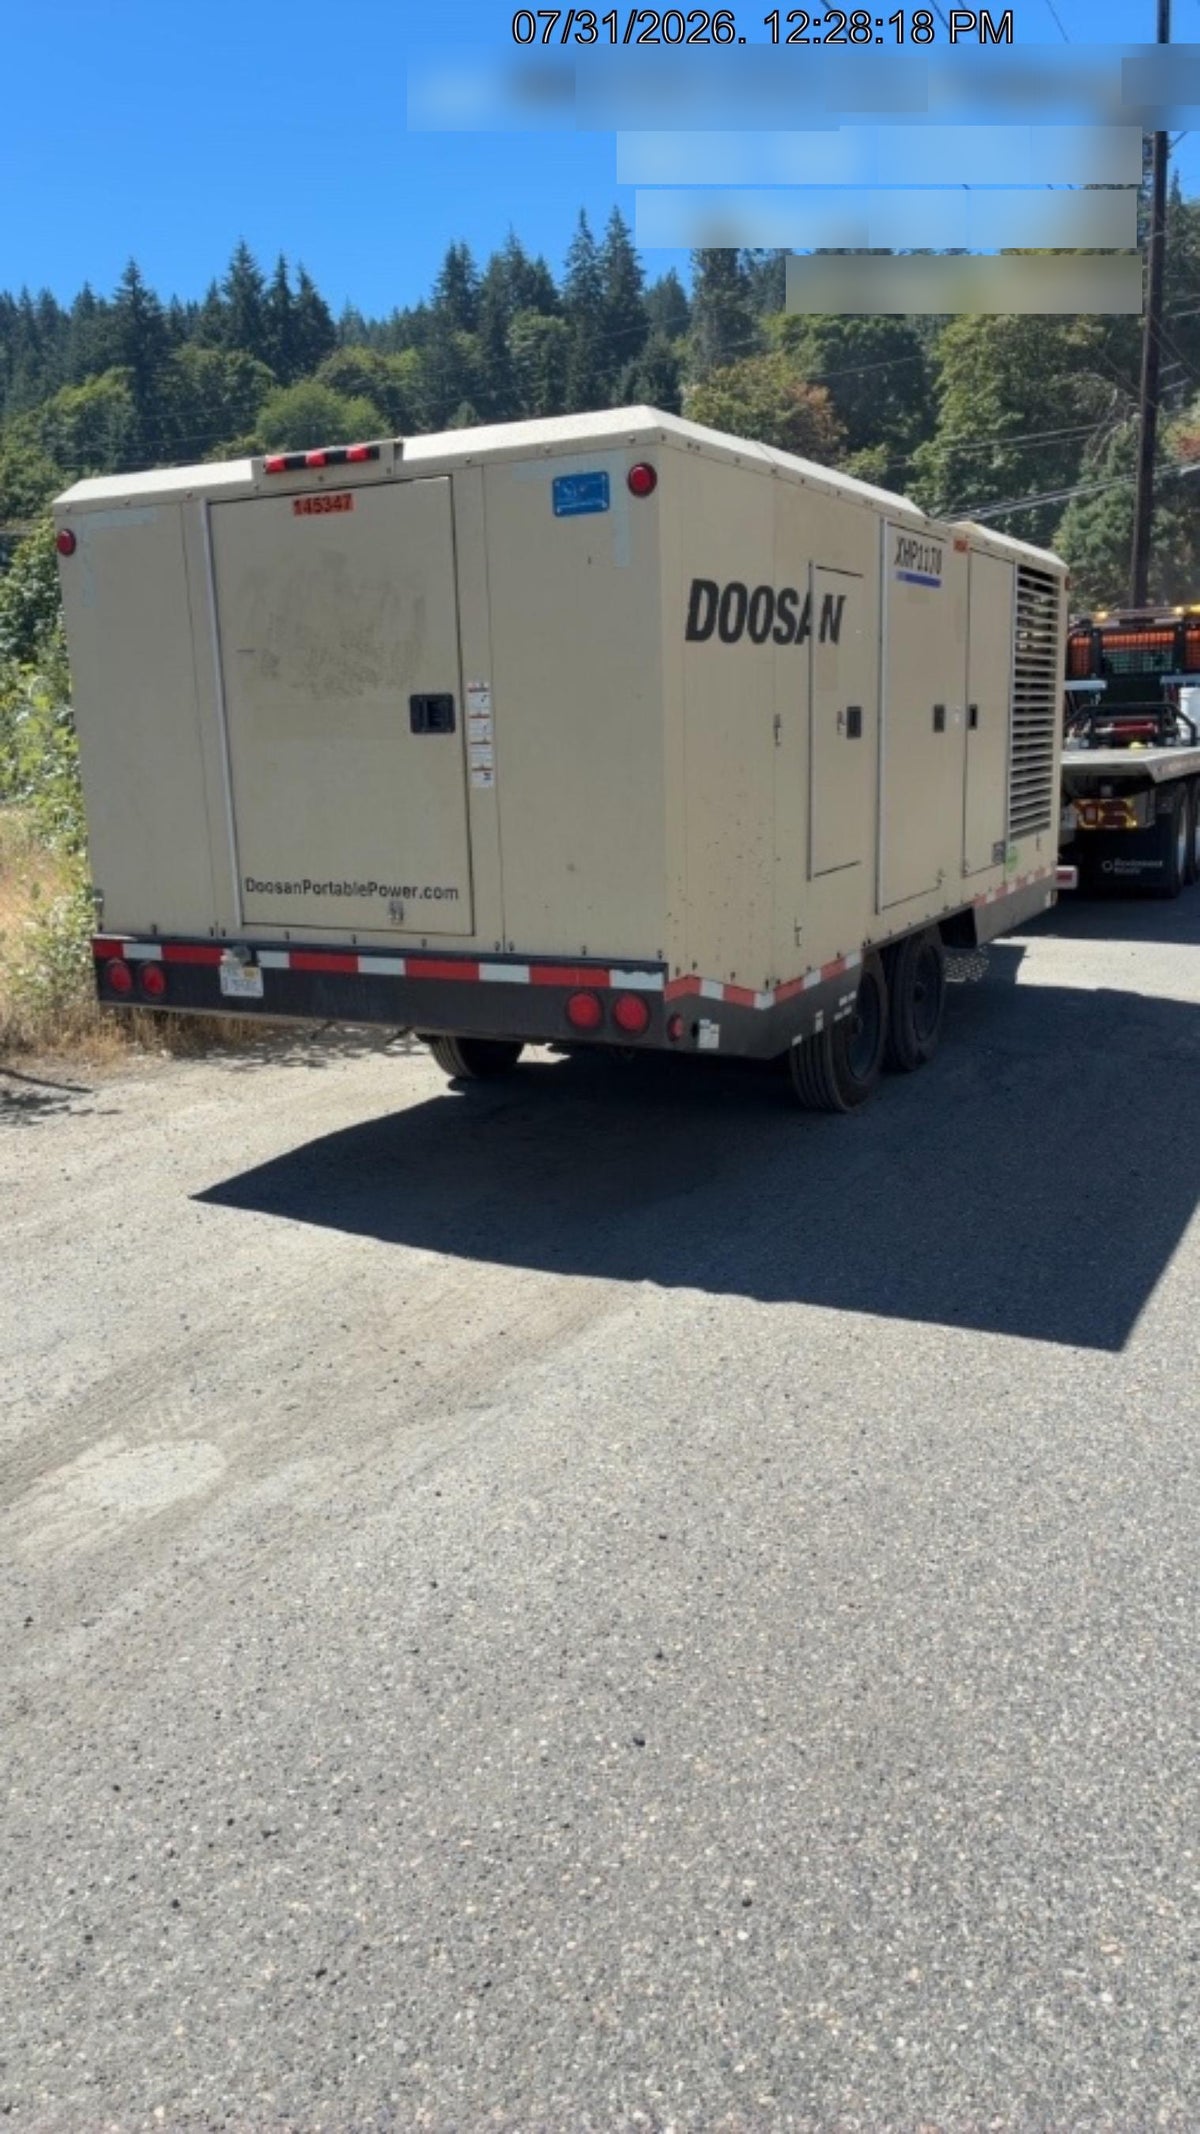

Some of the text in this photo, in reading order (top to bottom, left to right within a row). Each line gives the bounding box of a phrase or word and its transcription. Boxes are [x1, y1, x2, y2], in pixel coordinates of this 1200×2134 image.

[293, 493, 352, 515] 145347
[685, 577, 846, 645] DOOSAN
[245, 877, 459, 900] DoosanPortablePower.com
